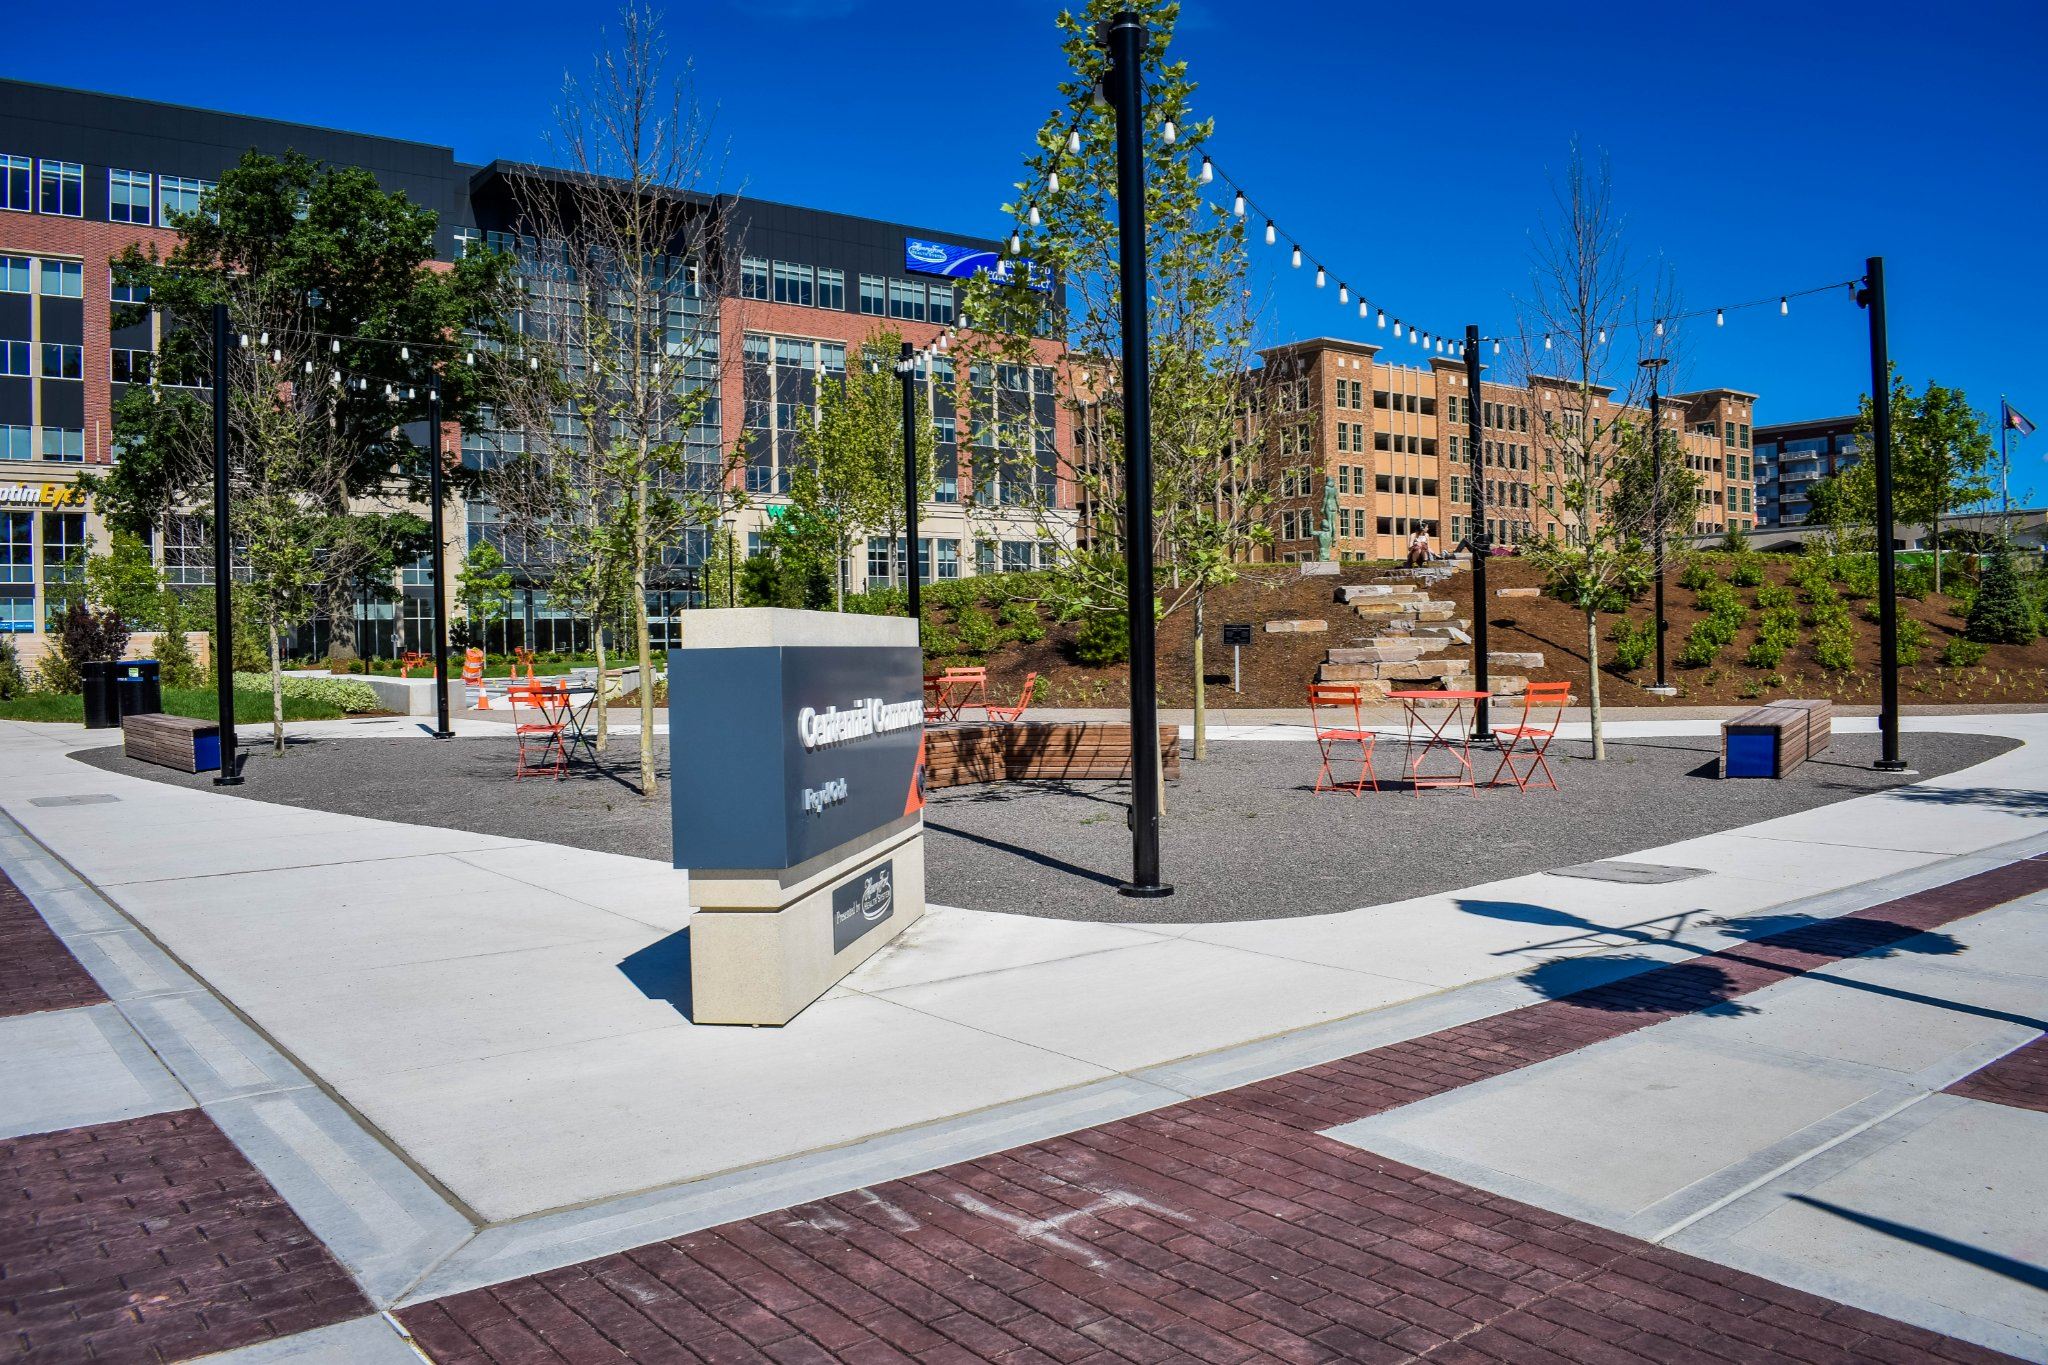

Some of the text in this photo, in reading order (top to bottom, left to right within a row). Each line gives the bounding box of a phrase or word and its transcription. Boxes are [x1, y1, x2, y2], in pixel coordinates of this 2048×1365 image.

[798, 698, 924, 747] Centennial Commons
[802, 778, 848, 813] Royal Oak
